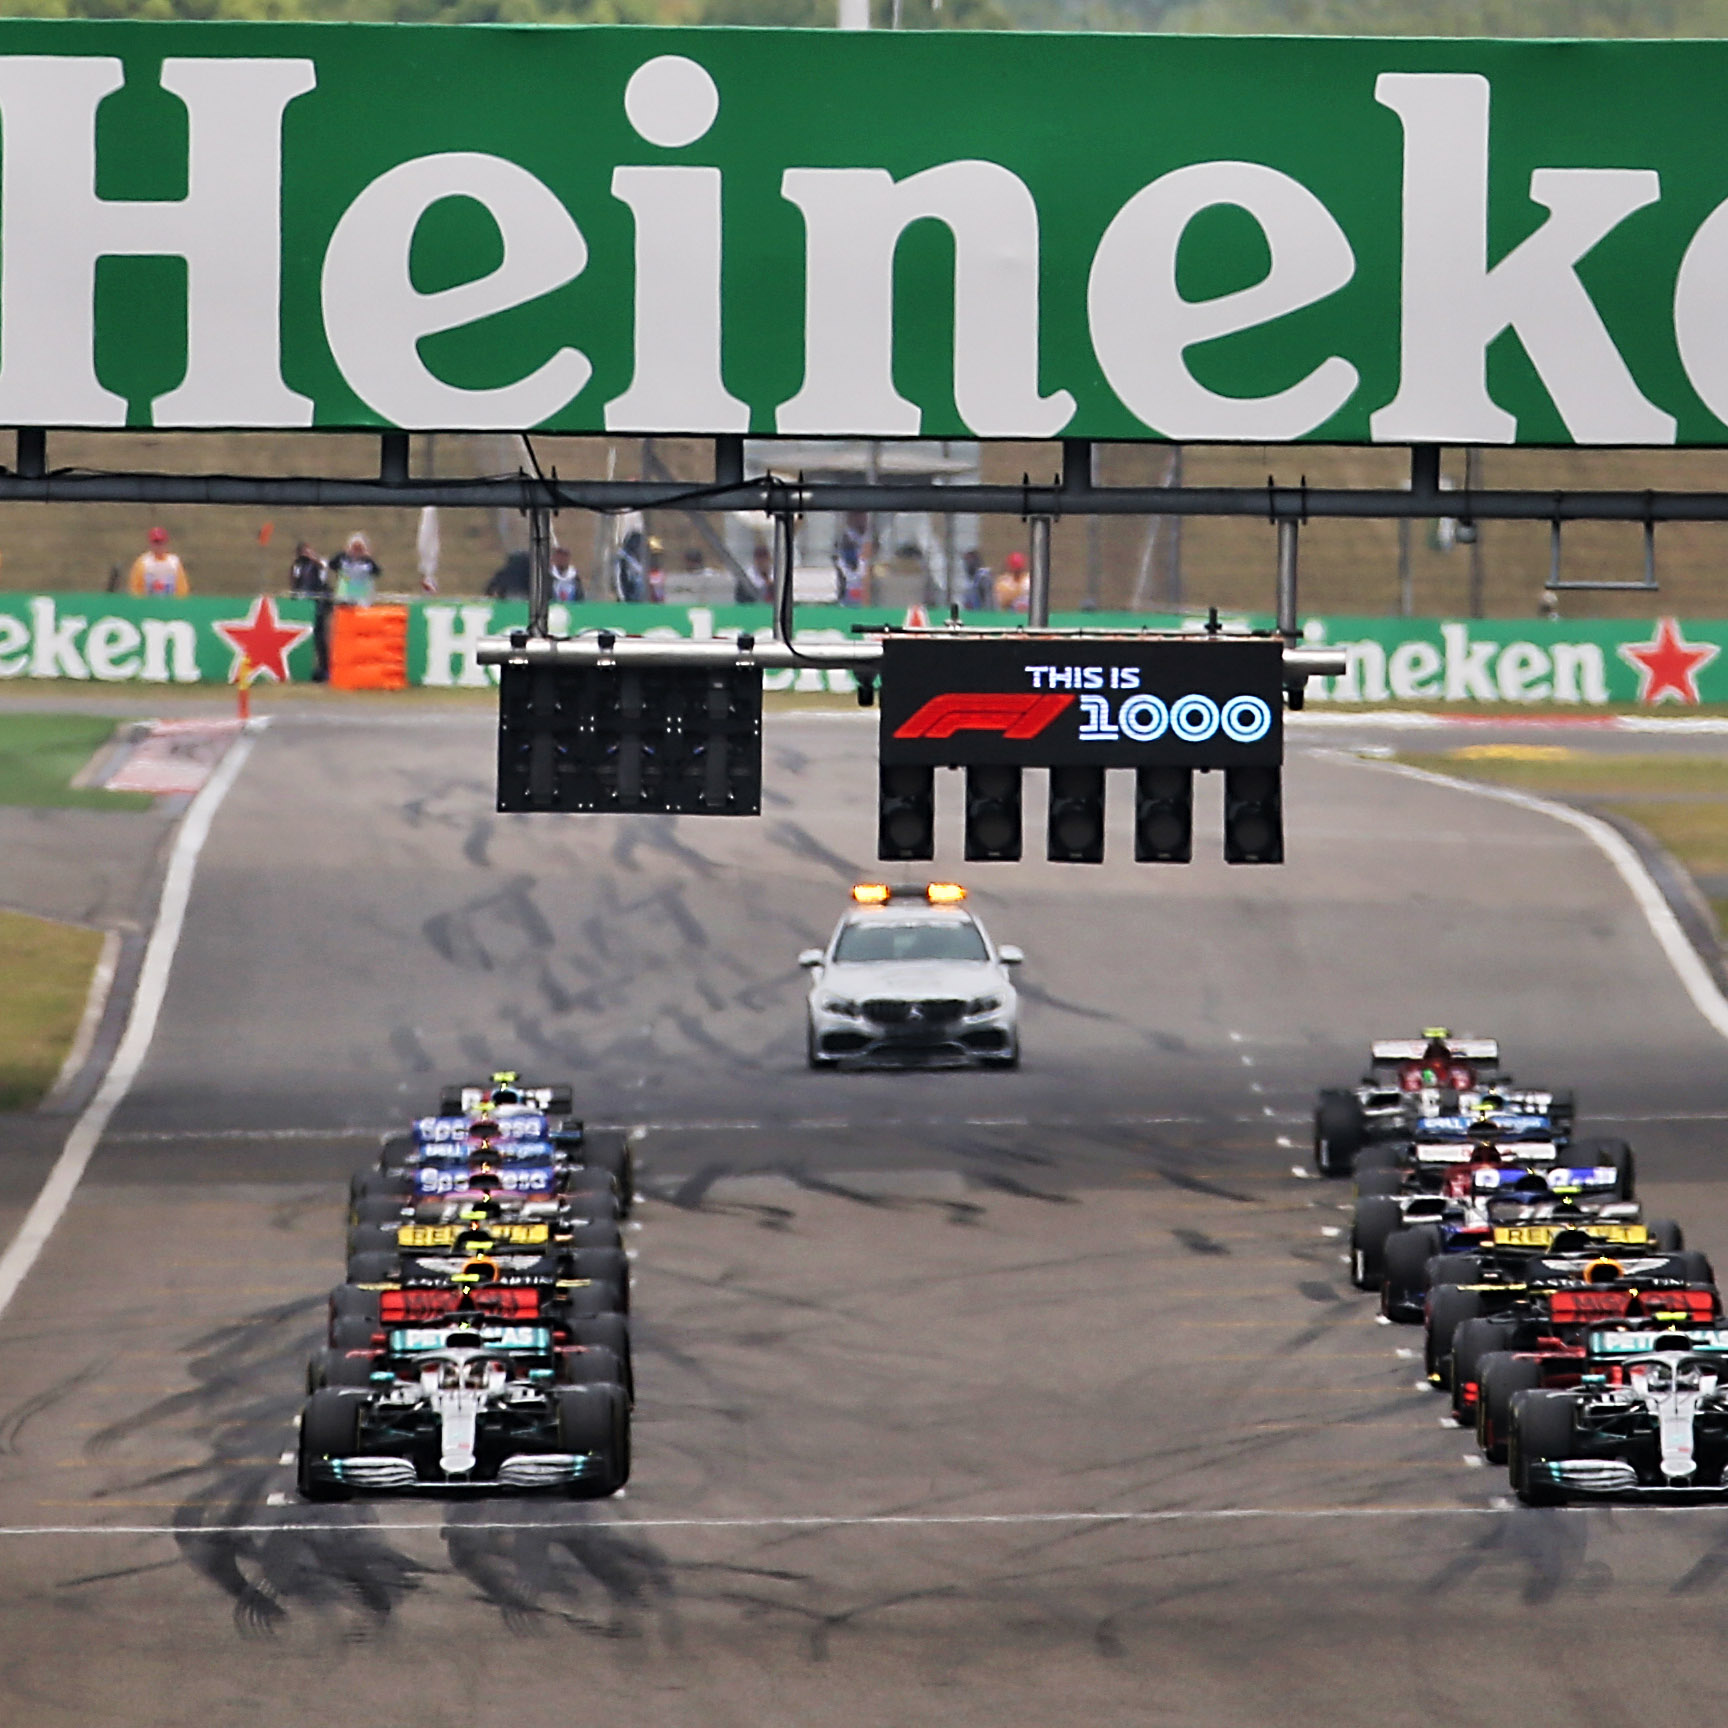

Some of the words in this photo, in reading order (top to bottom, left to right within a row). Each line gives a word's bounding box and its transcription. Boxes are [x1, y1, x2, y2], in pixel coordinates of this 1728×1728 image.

[1024, 665, 1104, 689] THIS
[1110, 666, 1140, 689] IS
[1078, 693, 1272, 743] 1000
